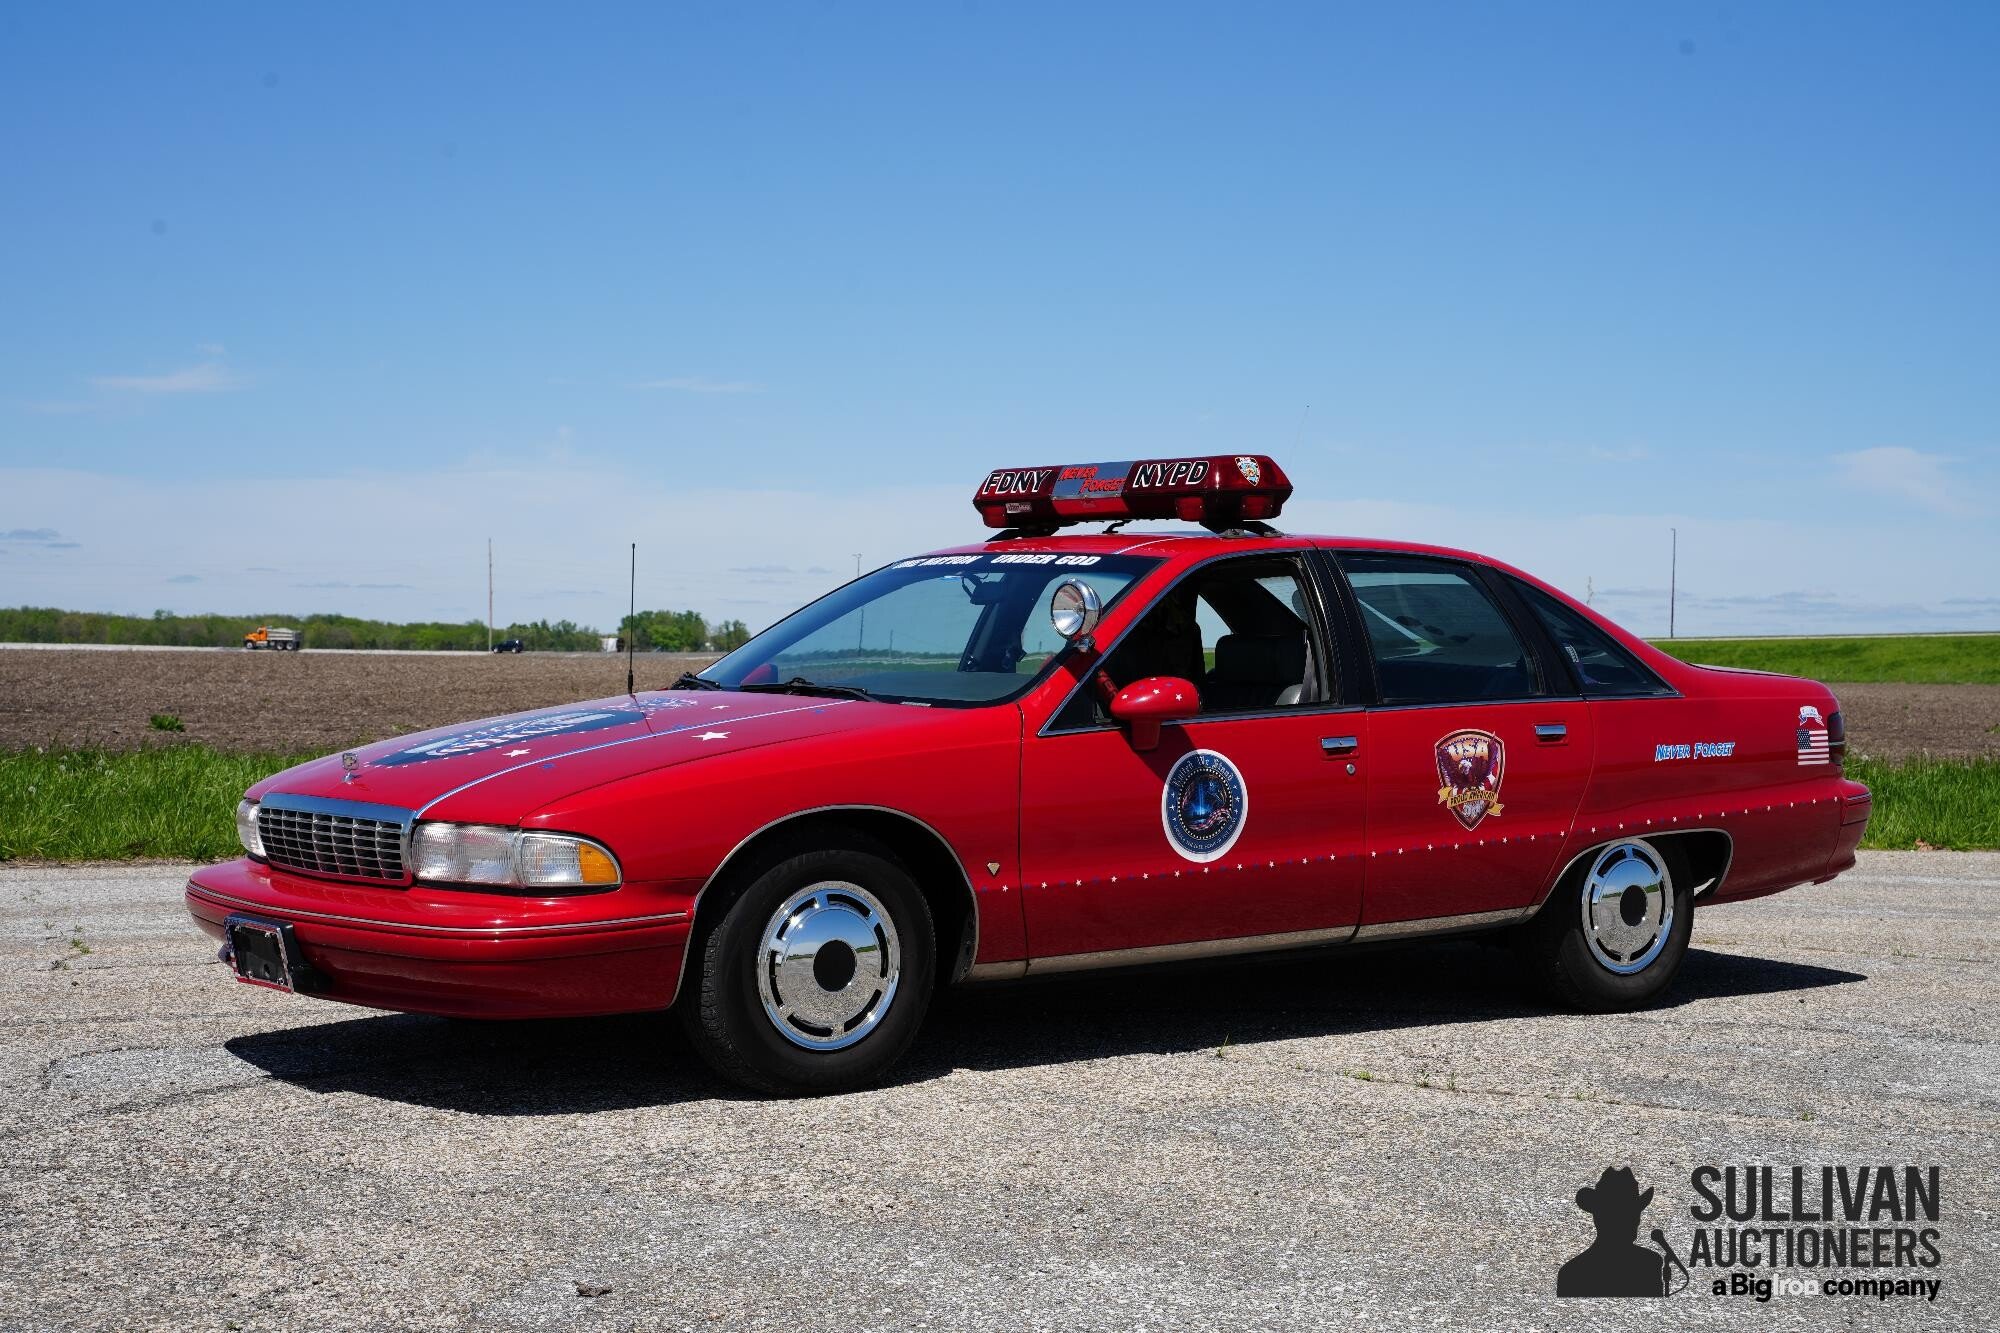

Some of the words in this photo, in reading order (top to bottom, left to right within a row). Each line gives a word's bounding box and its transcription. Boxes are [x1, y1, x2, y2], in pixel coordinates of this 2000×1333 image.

[982, 469, 1052, 494] FDNY
[1060, 466, 1098, 481] NEVER
[1133, 461, 1210, 488] NYPD
[1080, 478, 1126, 493] FORGET
[990, 554, 1058, 565] UNDER
[1055, 556, 1101, 566] GOD
[1446, 738, 1489, 760] USA
[1654, 744, 1691, 763] NEVER
[1694, 741, 1736, 760] FORGET
[1450, 793, 1469, 806] PROUD
[1468, 790, 1496, 801] AMERICAN
